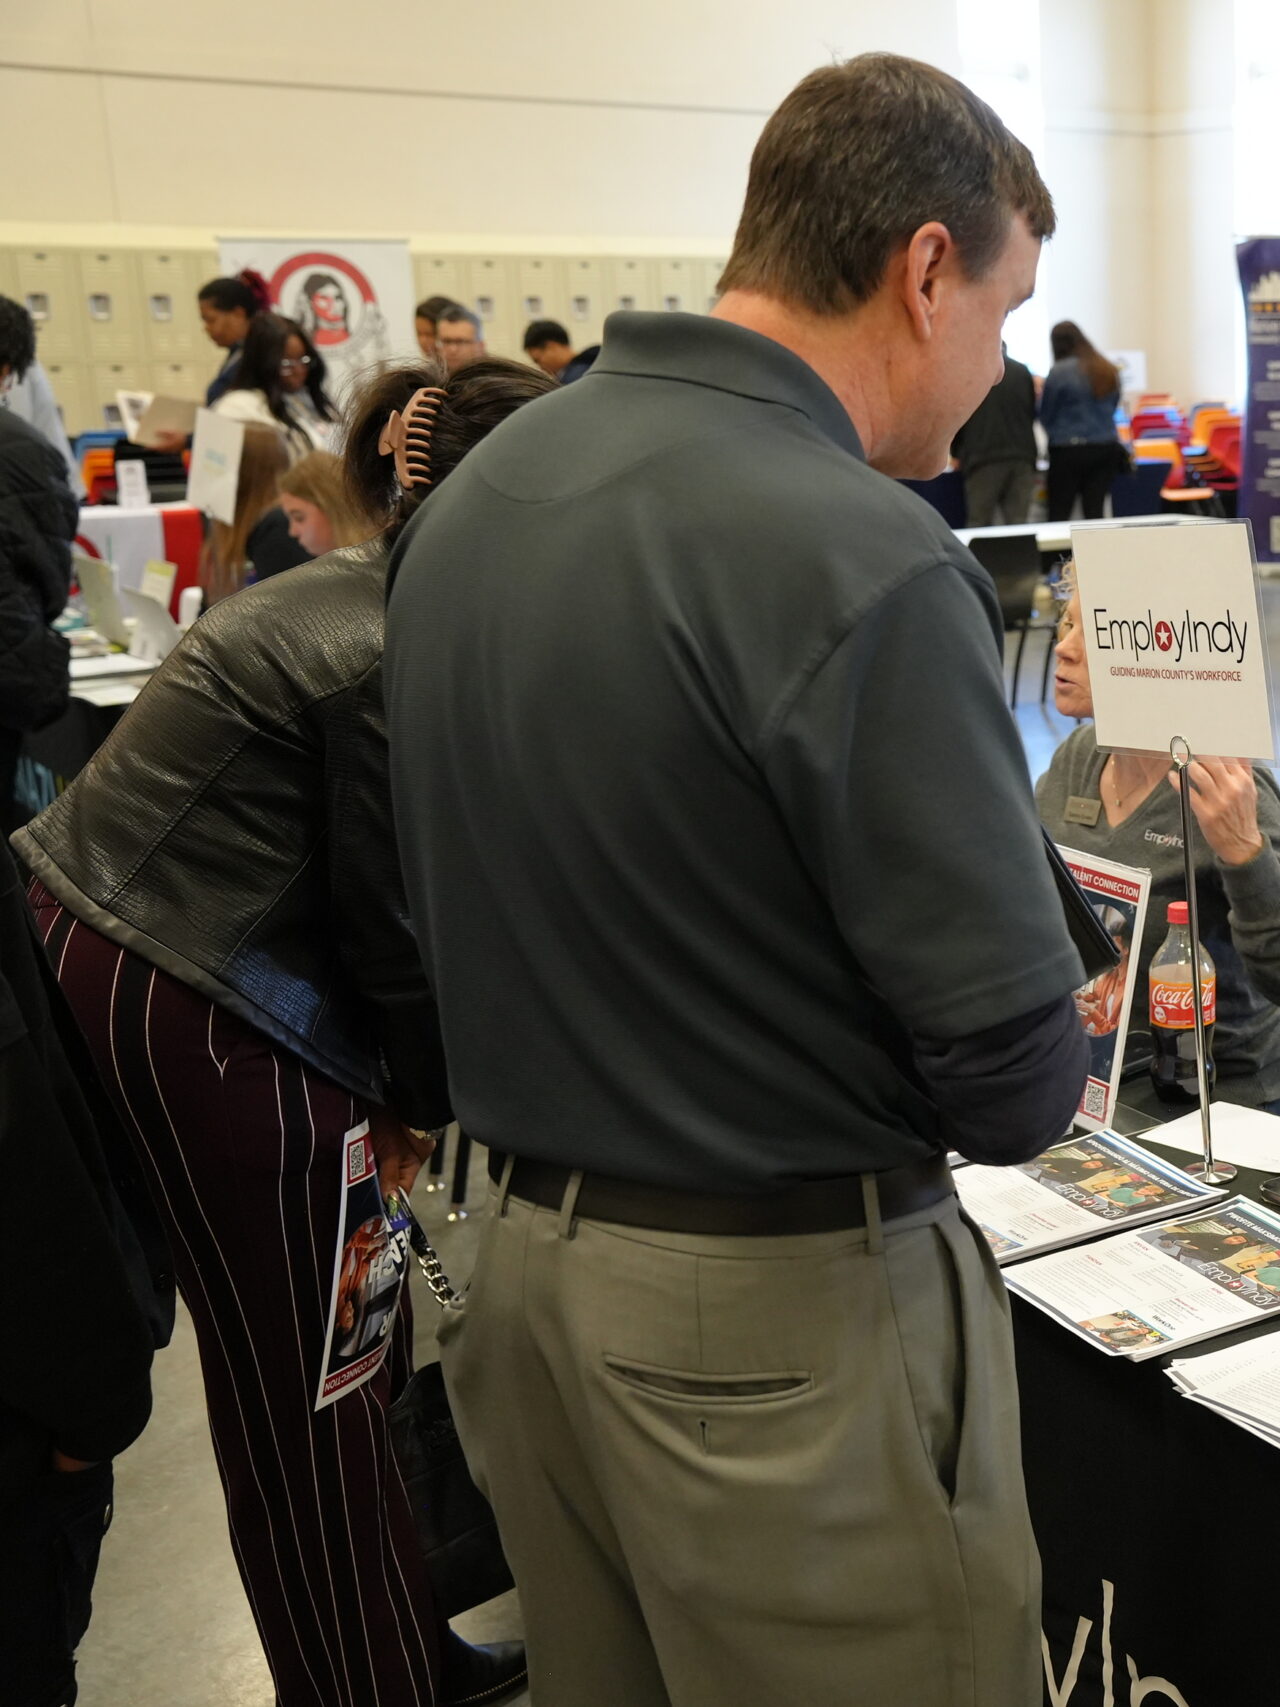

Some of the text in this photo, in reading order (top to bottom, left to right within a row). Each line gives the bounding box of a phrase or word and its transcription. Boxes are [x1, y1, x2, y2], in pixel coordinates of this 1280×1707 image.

[1094, 608, 1247, 663] EmployIndy
[1110, 666, 1241, 682] GUIDING MARION COUNTY'S WORKFORCE
[1093, 876, 1139, 898] CONNECTION
[1197, 1261, 1280, 1306] EmployIndy
[324, 1362, 368, 1393] CONNECTION
